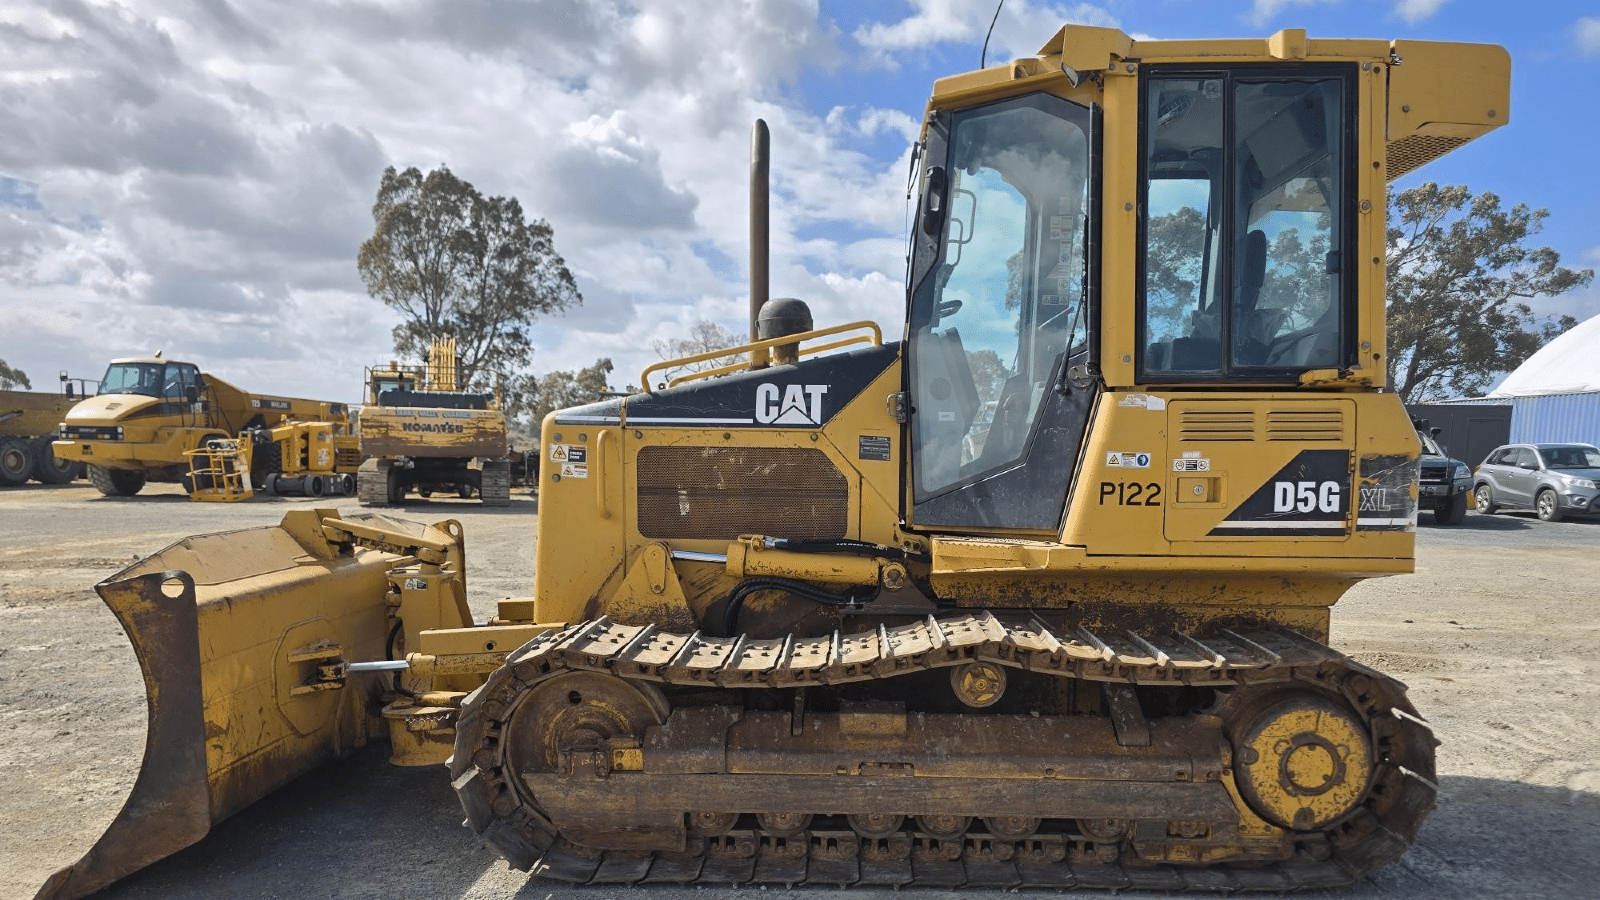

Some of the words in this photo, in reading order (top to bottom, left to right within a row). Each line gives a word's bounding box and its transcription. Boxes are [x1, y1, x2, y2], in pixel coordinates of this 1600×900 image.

[756, 382, 828, 424] CAT
[1099, 482, 1161, 506] P122
[1273, 480, 1340, 513] D5G
[1359, 488, 1391, 512] XL
